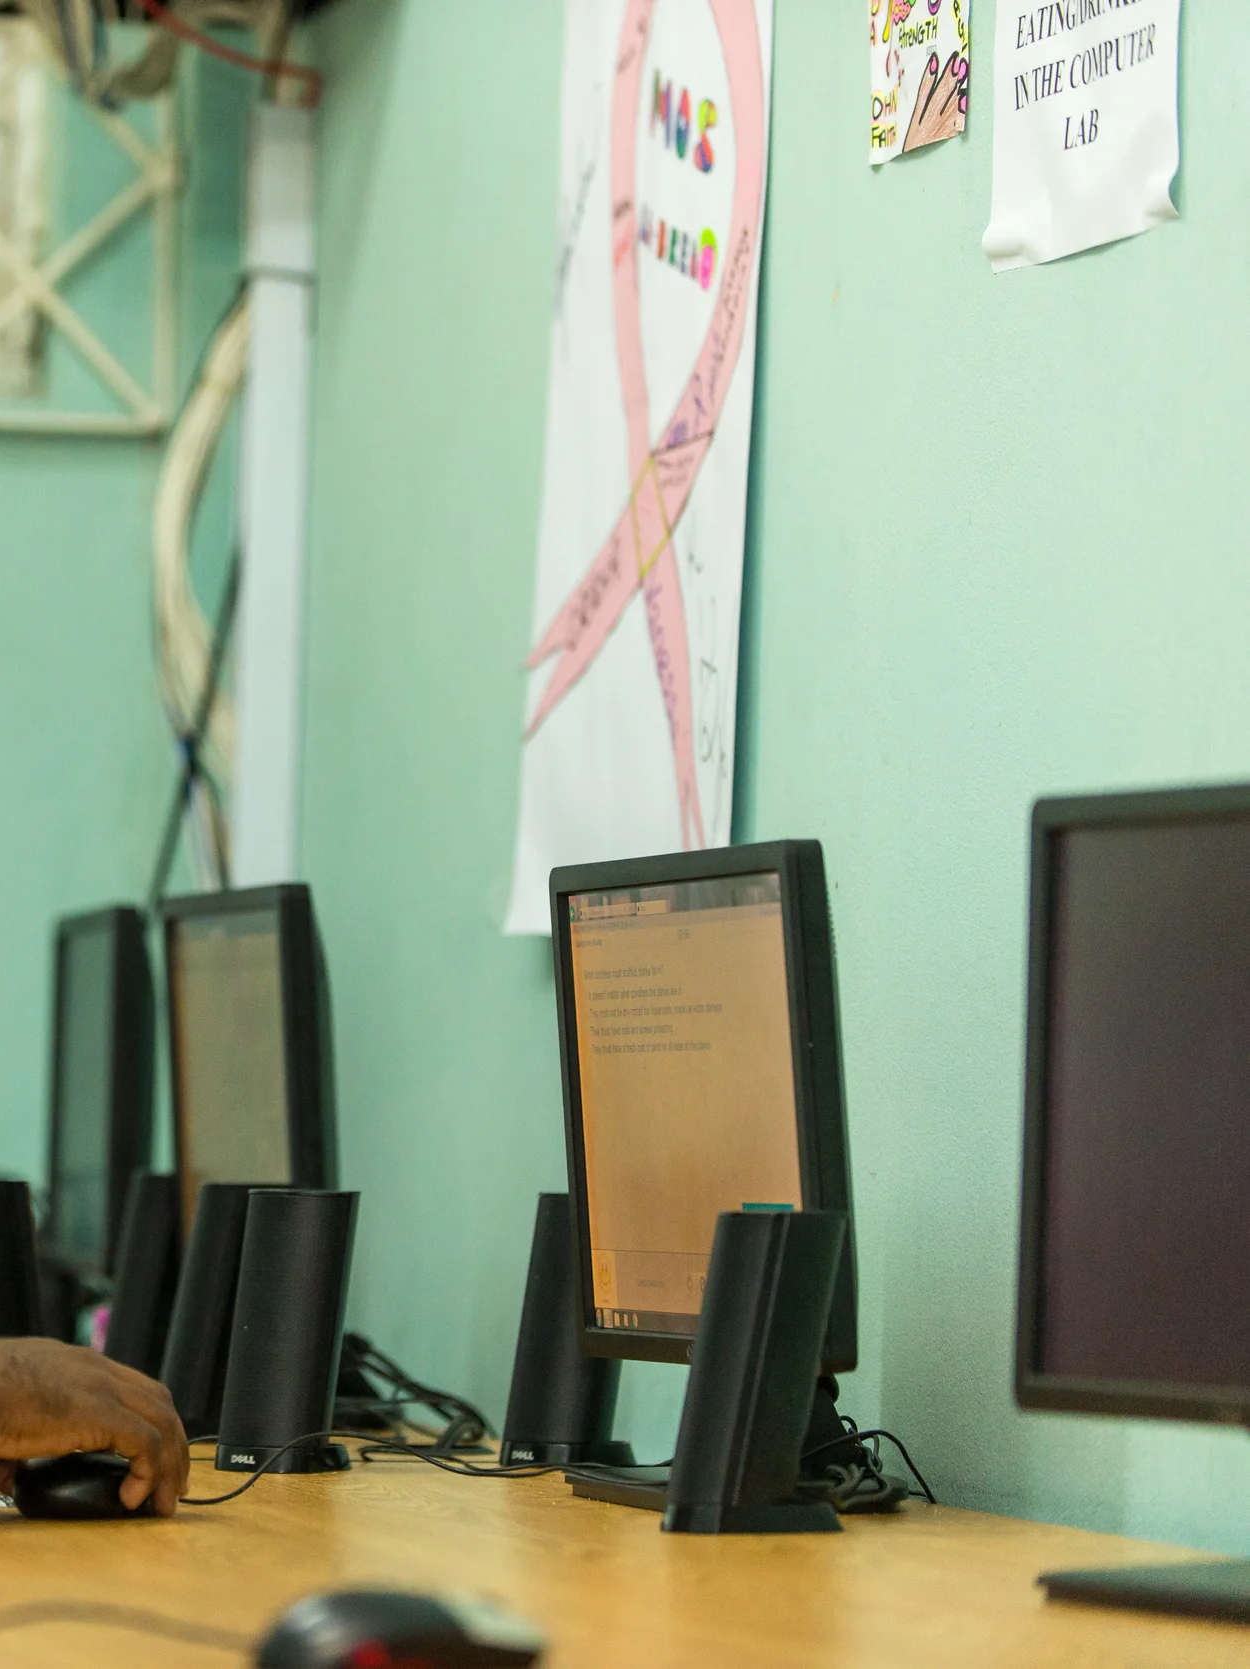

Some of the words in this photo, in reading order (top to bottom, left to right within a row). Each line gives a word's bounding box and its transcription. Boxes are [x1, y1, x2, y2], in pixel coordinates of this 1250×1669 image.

[1016, 0, 1143, 49] EATING/DR
[1014, 72, 1030, 111] IN
[1032, 59, 1066, 102] THE
[1069, 23, 1156, 89] COMPUTER
[1064, 109, 1100, 150] LAB
[230, 1454, 256, 1465] DELL
[511, 1451, 535, 1461] DELL
